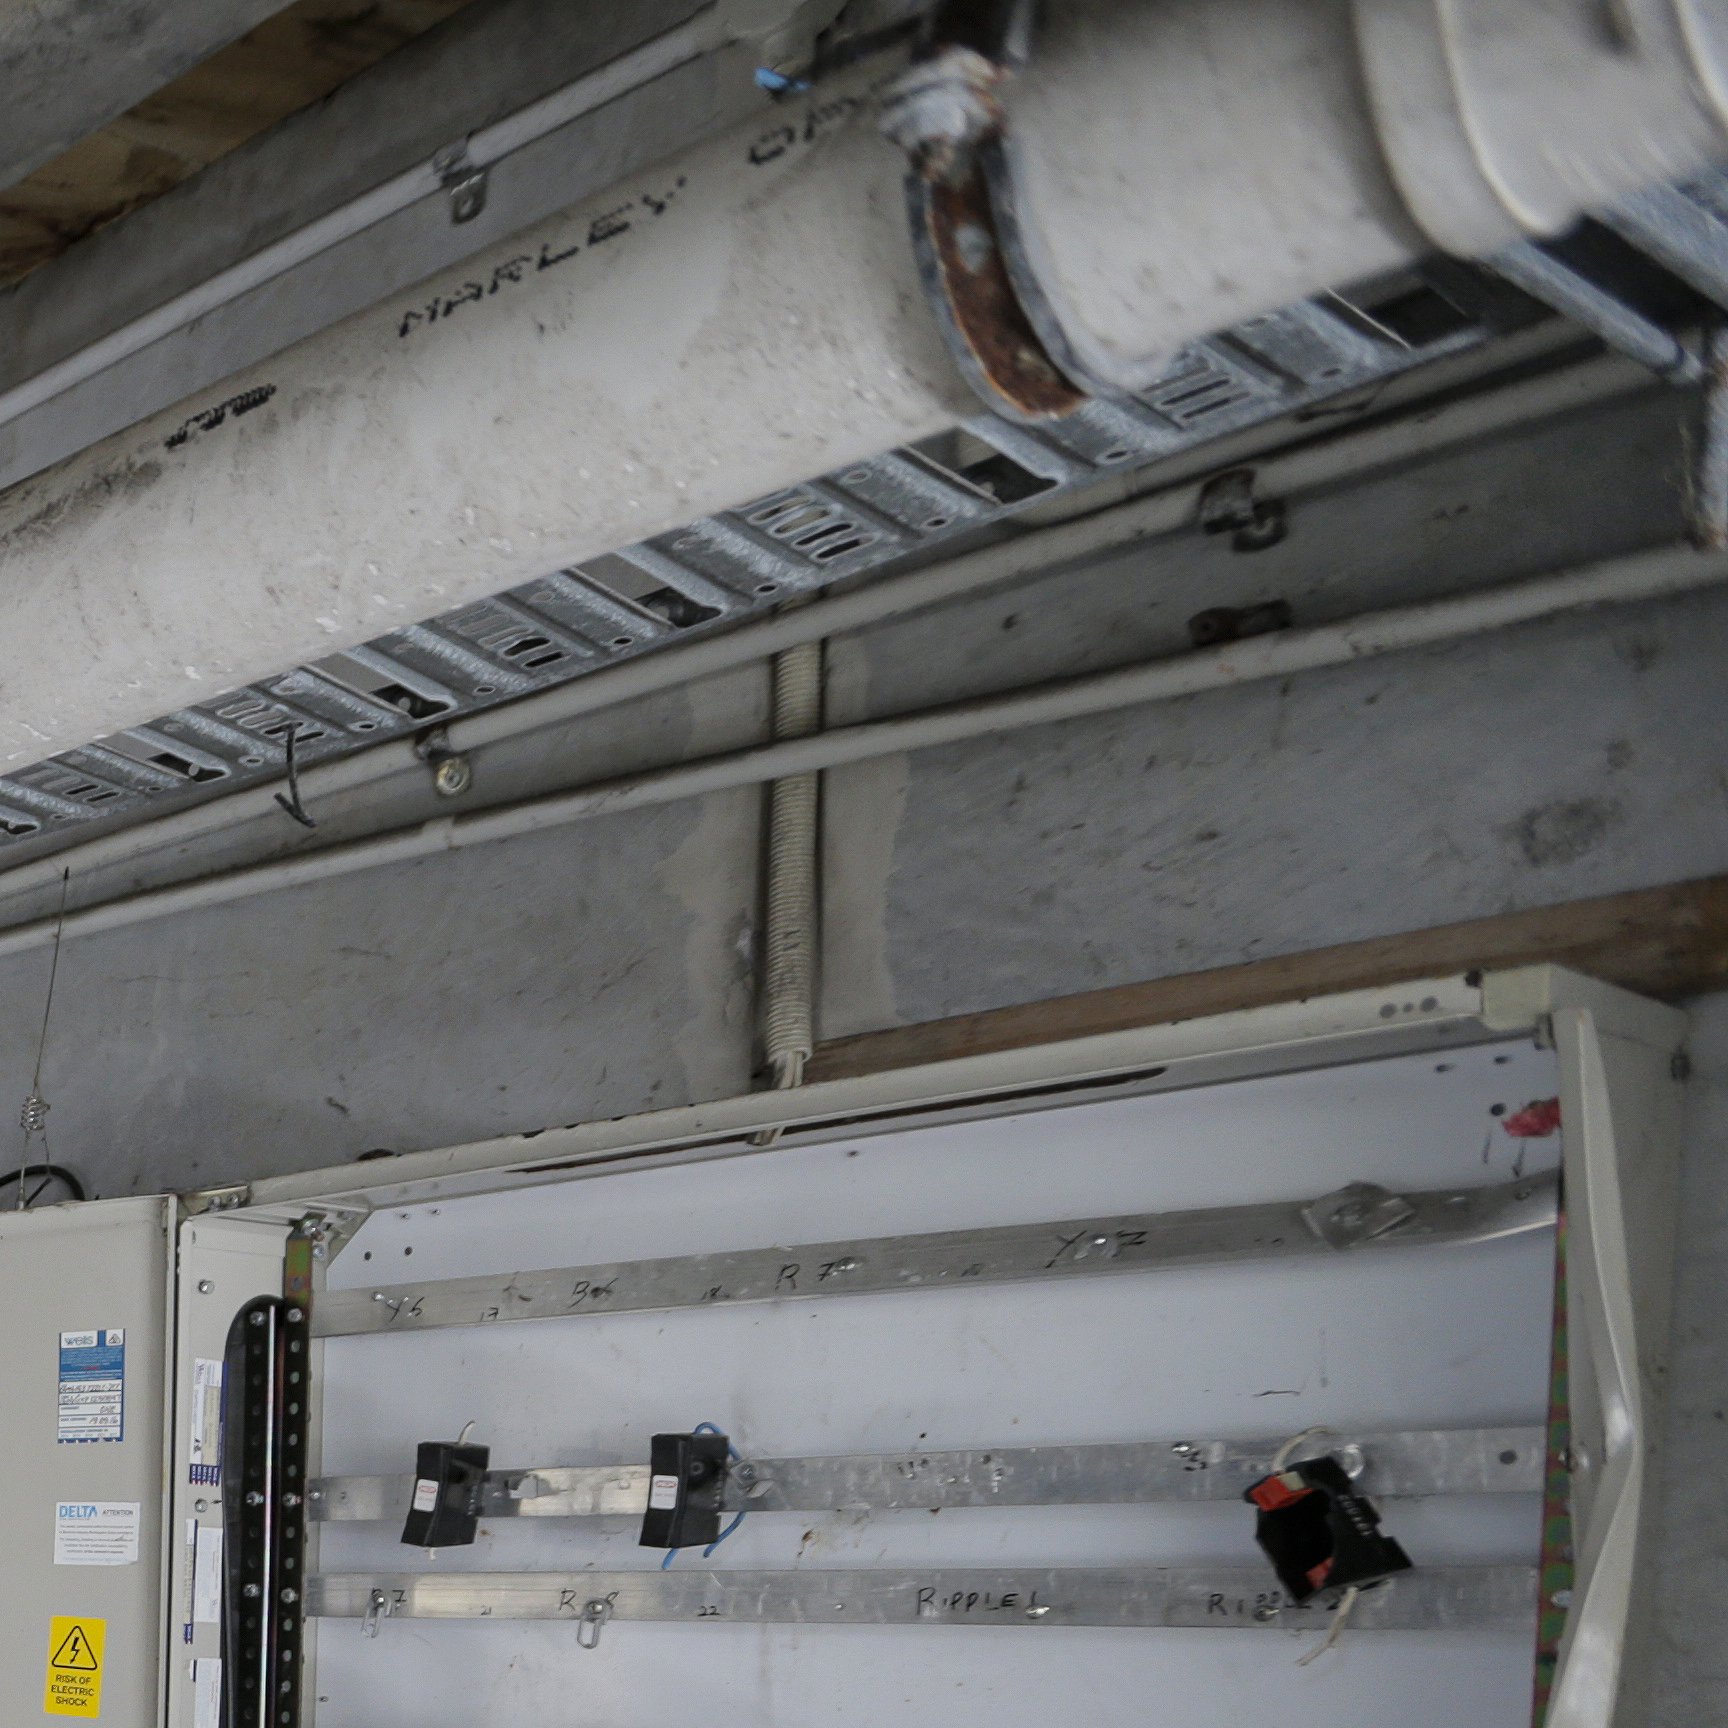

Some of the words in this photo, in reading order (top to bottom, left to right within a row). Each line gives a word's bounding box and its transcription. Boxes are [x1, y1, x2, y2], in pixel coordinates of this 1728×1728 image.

[59, 1505, 98, 1518] DELTA
[559, 1588, 577, 1611] R
[915, 1587, 1019, 1616] RIPPLE
[55, 1674, 77, 1684] RISK
[79, 1676, 91, 1685] OF
[51, 1684, 95, 1697] ELECTRIC
[55, 1695, 88, 1706] SHOCK
